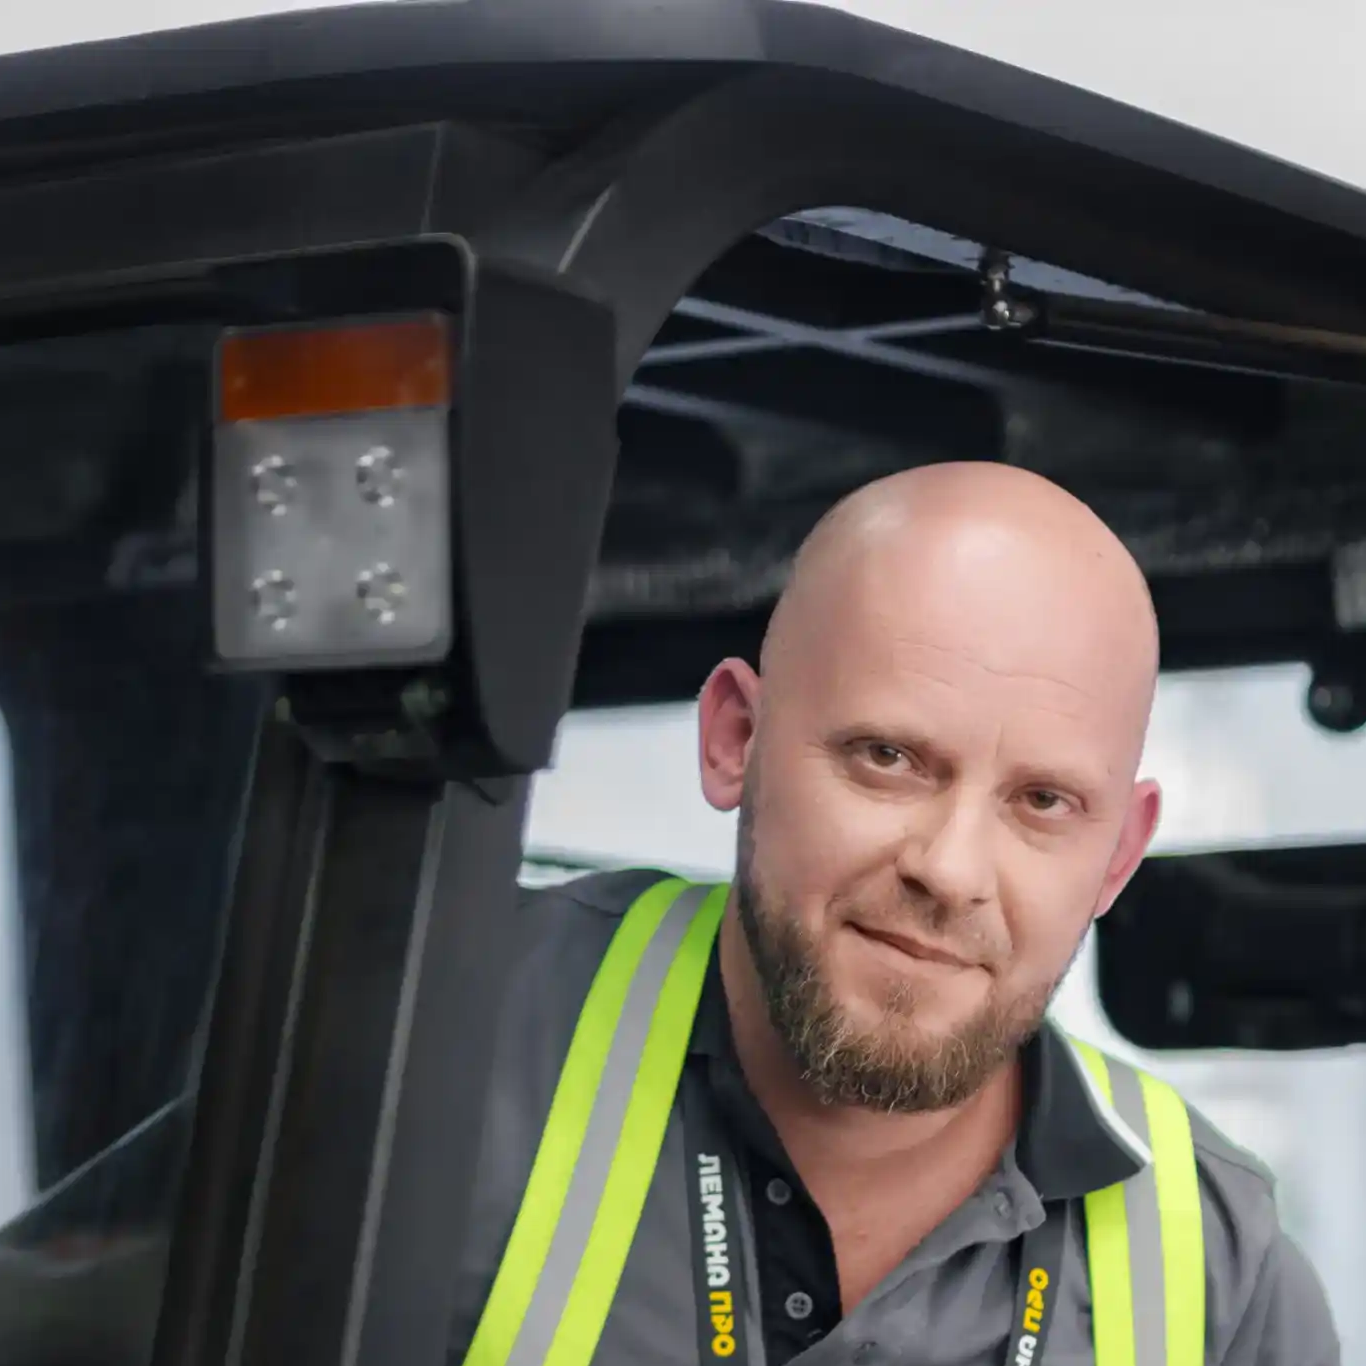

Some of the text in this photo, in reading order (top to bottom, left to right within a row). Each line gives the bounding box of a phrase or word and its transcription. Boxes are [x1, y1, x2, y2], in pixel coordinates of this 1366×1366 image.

[697, 1153, 736, 1357] ЛЕМАНА ПРО
[1023, 1267, 1049, 1333] ПРО
